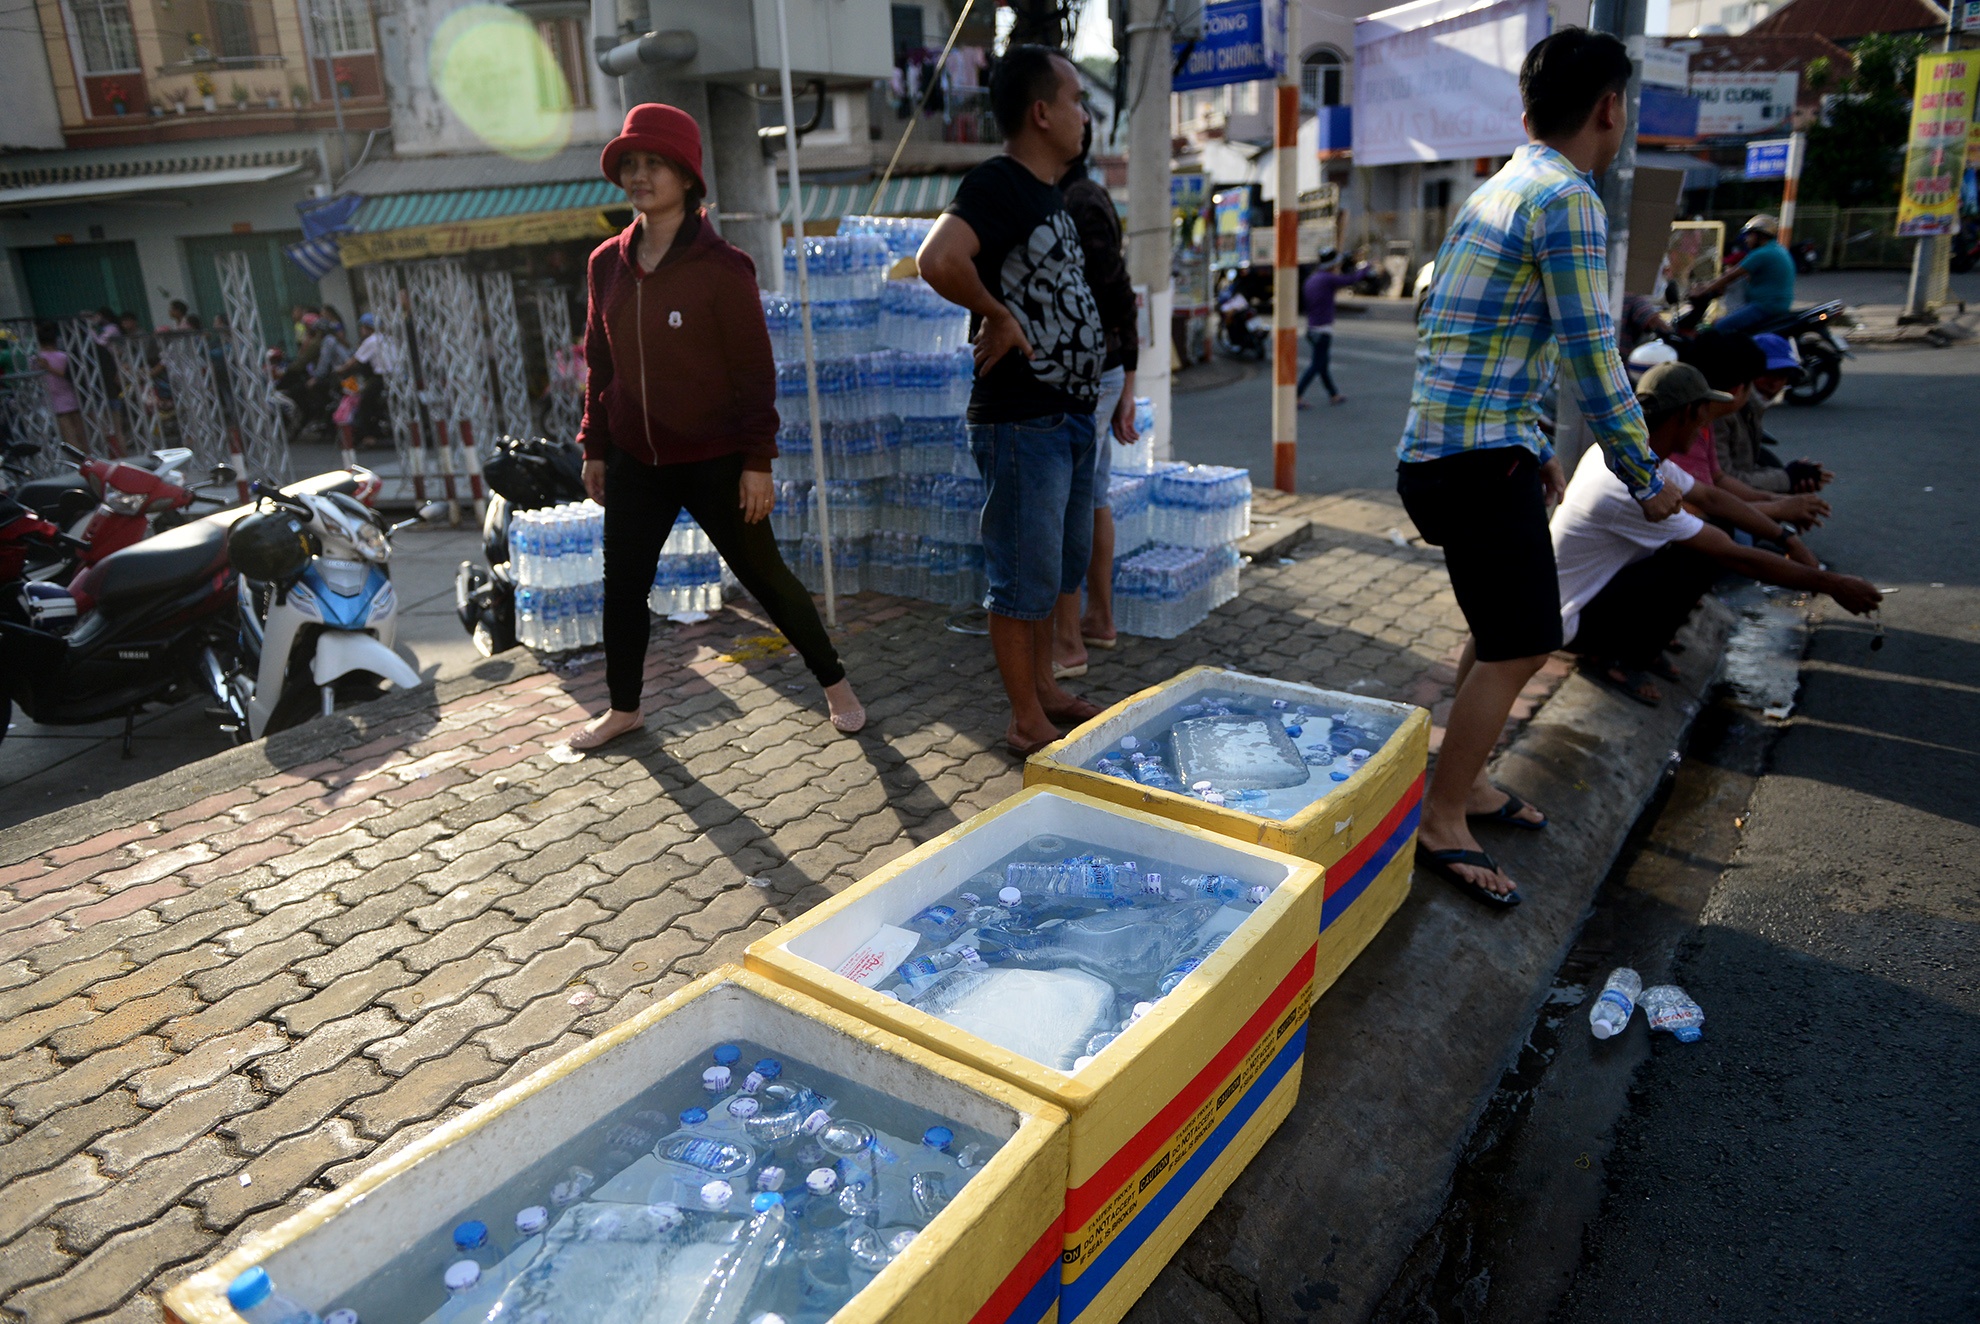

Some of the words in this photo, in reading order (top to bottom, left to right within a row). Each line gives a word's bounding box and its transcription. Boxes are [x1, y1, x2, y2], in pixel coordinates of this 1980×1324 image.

[1140, 1153, 1170, 1192] CAUTION
[1084, 1235, 1095, 1250] DO
[1095, 1215, 1111, 1238] NOT
[1111, 1191, 1136, 1220] ACCEPT
[1087, 1238, 1104, 1258] SEAL
[1111, 1200, 1138, 1232] BROKEN
[1063, 1247, 1080, 1264] ON
